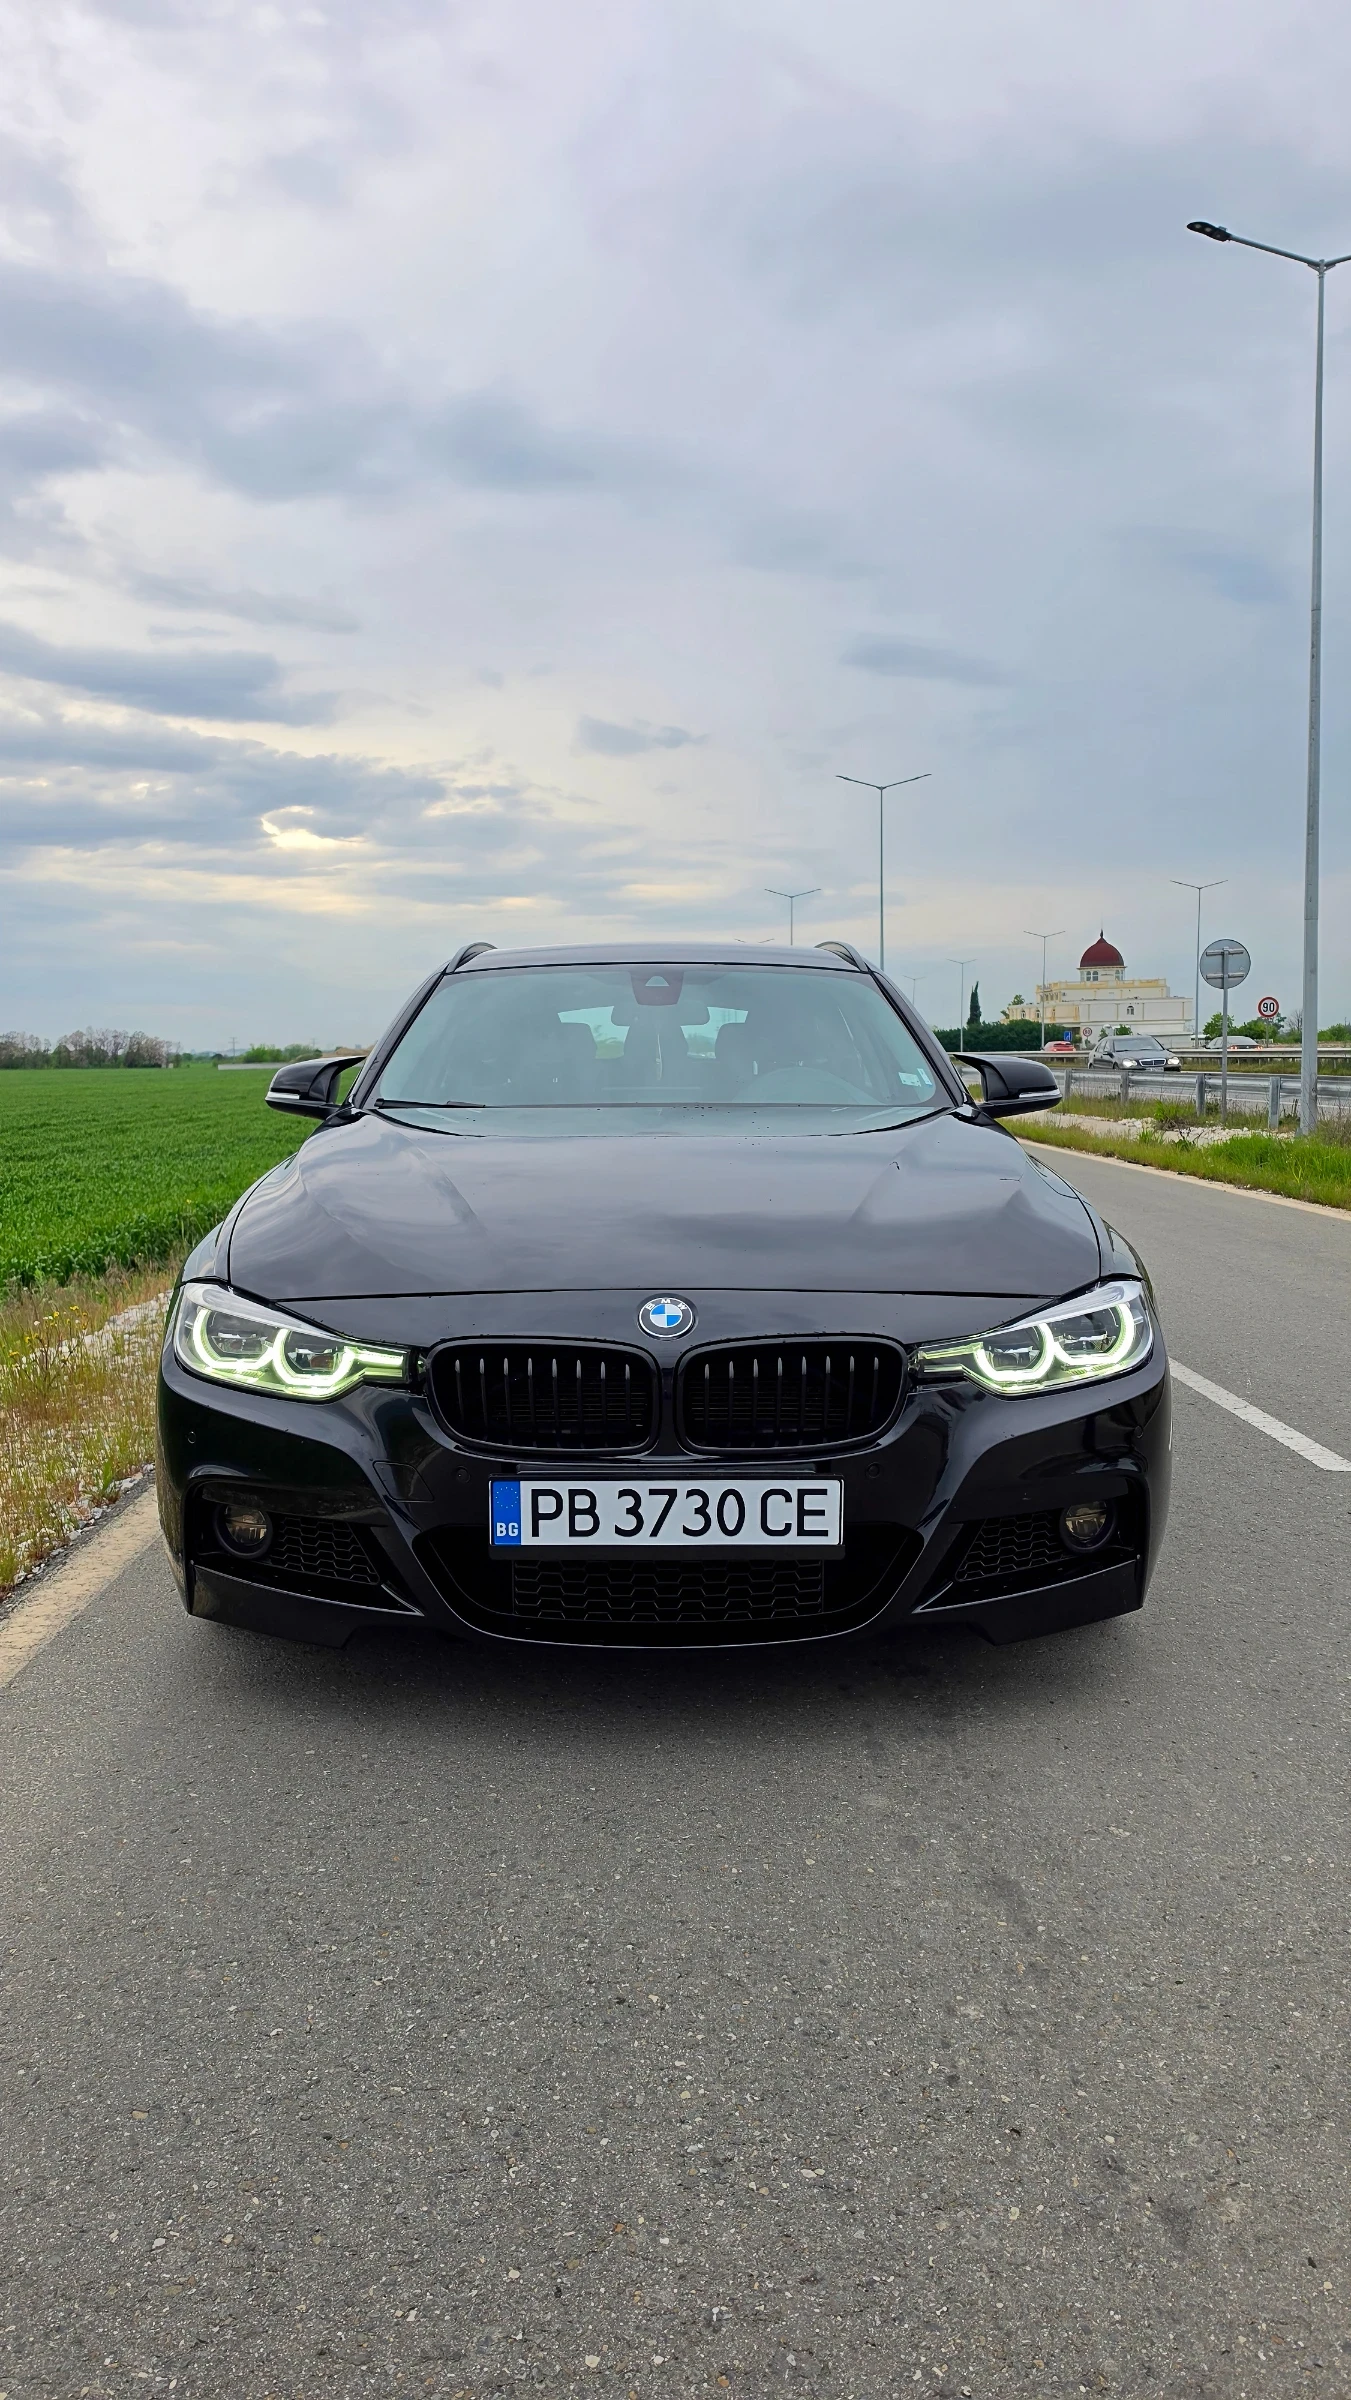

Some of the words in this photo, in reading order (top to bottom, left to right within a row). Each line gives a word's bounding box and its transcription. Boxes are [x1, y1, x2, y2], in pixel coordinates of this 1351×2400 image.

[1263, 1002, 1275, 1012] 90
[645, 1298, 688, 1310] BMW
[530, 1488, 601, 1538] PB
[614, 1488, 746, 1538] 3730
[760, 1488, 829, 1538] CE
[496, 1522, 519, 1537] BG
